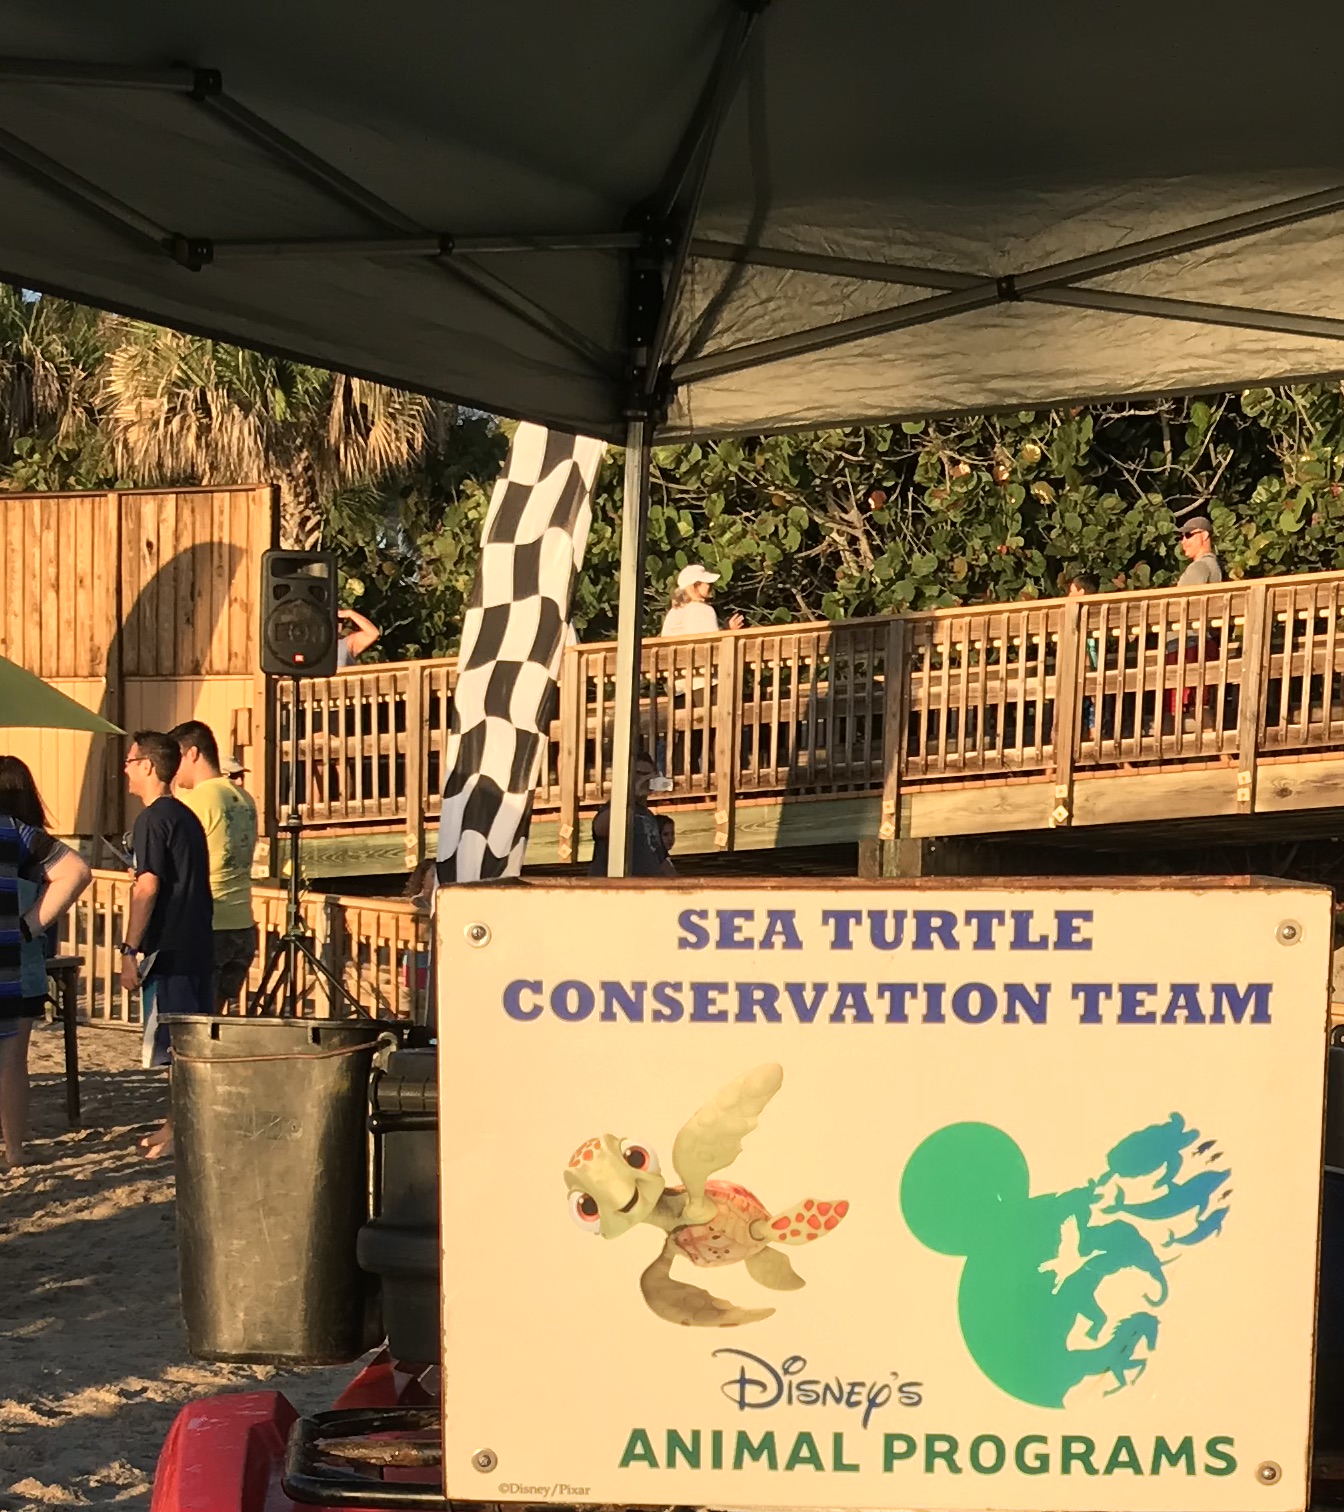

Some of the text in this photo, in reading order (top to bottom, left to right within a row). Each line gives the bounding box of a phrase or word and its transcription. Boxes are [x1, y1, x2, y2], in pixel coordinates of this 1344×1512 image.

[677, 908, 1095, 952] SEA TURTLE
[501, 979, 1274, 1025] CONSERVATION TEAM
[711, 1347, 924, 1430] Disney's
[617, 1427, 1238, 1477] ANIMAL PROGRAMS
